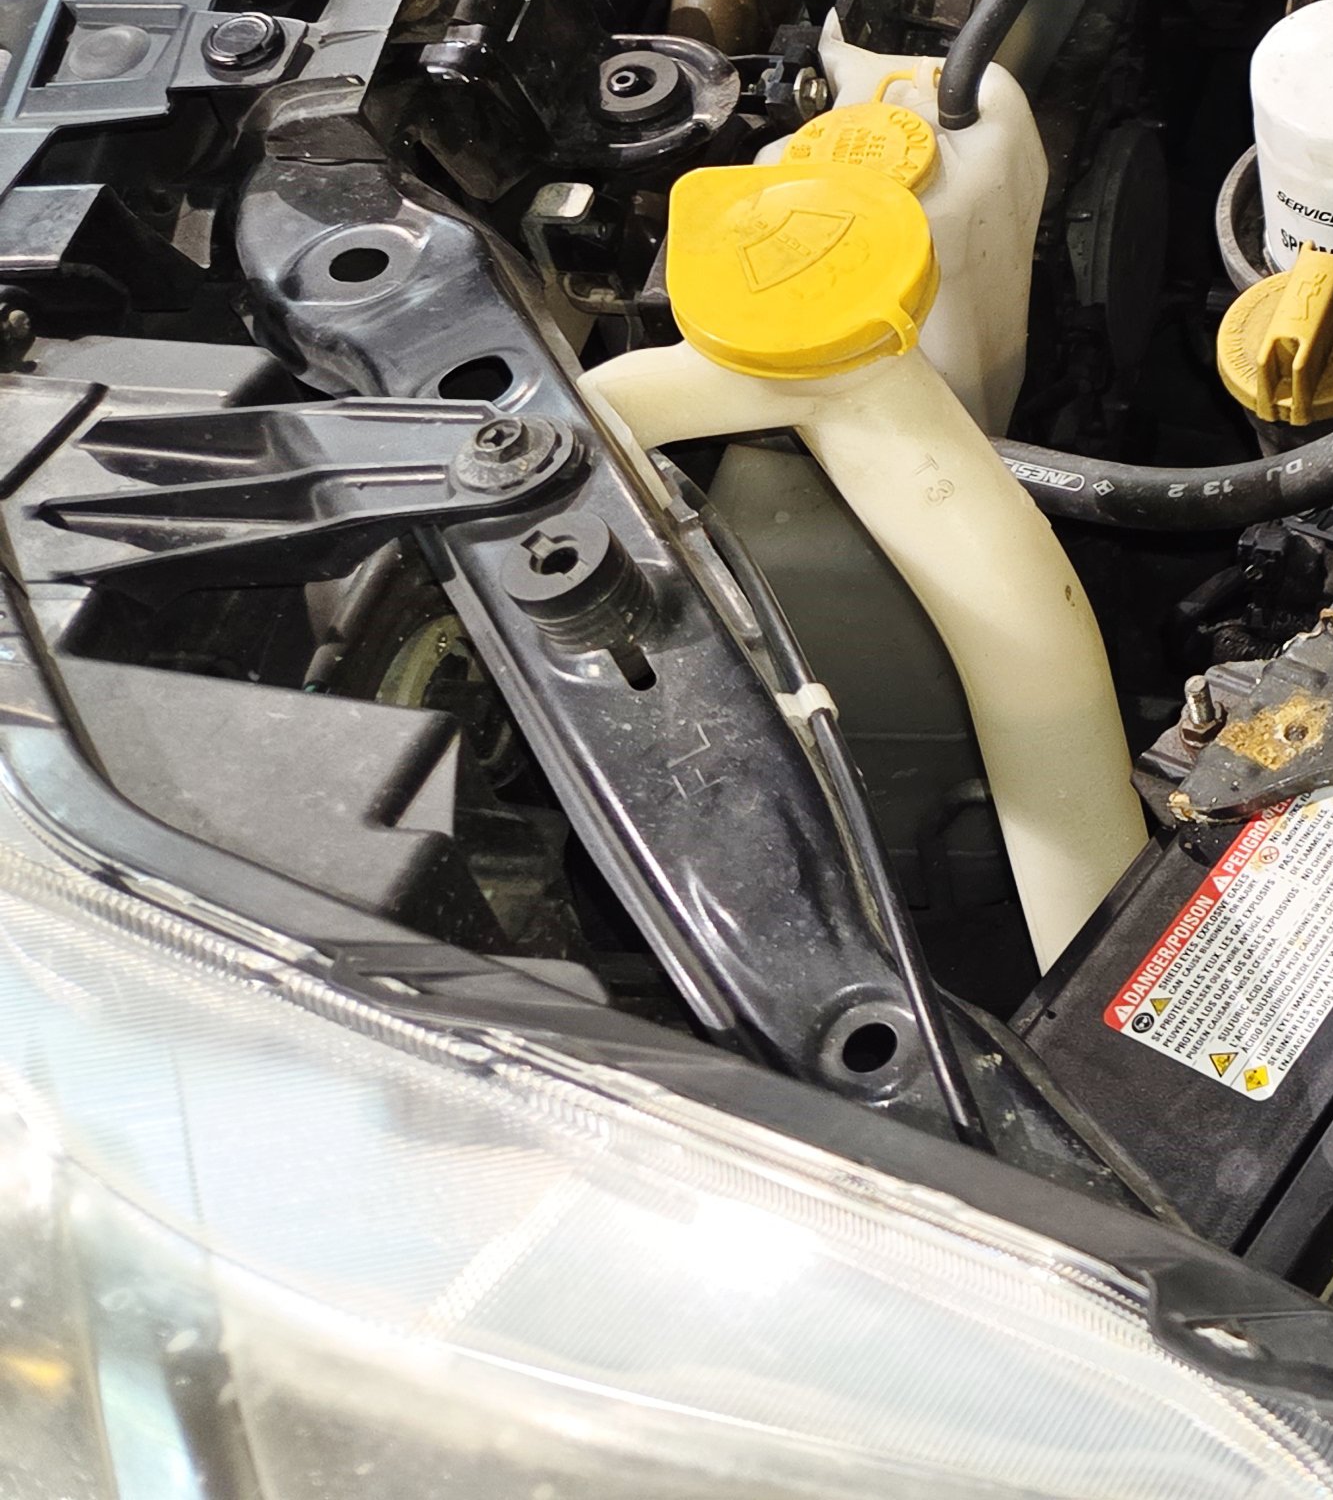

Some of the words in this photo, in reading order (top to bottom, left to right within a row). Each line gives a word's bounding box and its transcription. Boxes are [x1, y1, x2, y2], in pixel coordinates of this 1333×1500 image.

[888, 109, 929, 182] COOLAN
[1268, 828, 1283, 844] NO
[1277, 852, 1294, 871] PAS
[1280, 811, 1309, 847] SMOKING
[1288, 863, 1300, 876] DE
[1322, 818, 1333, 830] DE
[1300, 866, 1315, 882] NO
[1121, 890, 1216, 1007] DANGER/POISON
[1149, 1028, 1163, 1043] SE
[1189, 972, 1205, 990] LES
[1217, 933, 1234, 952] LES
[1229, 917, 1246, 936] GAZ
[1241, 877, 1276, 920] EXPLOSIFS
[1157, 959, 1184, 991] SHIELD
[1195, 897, 1231, 941] EXPLOSIVE
[1226, 871, 1250, 900] GASES
[1167, 977, 1184, 996] CAN
[1180, 952, 1202, 978] CAUSE
[1198, 913, 1231, 955] BLINDNESS
[1227, 902, 1240, 915] OR
[1173, 1015, 1206, 1055] PROTEJA
[1200, 997, 1218, 1018] LOS
[1230, 958, 1247, 977] LOS
[1242, 932, 1266, 961] GASES
[1261, 885, 1300, 935] EXPLOSIVOS
[1216, 1001, 1249, 1043] SULFURIC
[1244, 982, 1263, 1004] ACID
[1258, 966, 1275, 985] CAN
[1269, 944, 1290, 970] CAUSE
[1310, 900, 1323, 913] OR
[1250, 968, 1289, 1018] SULFURIQUE
[1284, 949, 1303, 970] PEUT
[1297, 922, 1321, 953] CAUSER
[1316, 913, 1328, 925] LA
[1288, 960, 1310, 986] PUEDE
[1305, 932, 1330, 963] CAUSAR
[1161, 1013, 1191, 1049] PEUVENT
[1186, 982, 1213, 1016] BLESSER
[1208, 971, 1222, 985] OU
[1217, 944, 1242, 974] RENDRE
[1184, 1028, 1211, 1061] PUEDEN
[1205, 998, 1233, 1031] CAUSAR
[1254, 1033, 1278, 1062] FLUSH
[1275, 1009, 1295, 1033] EYES
[1290, 957, 1332, 1012] IMMEDIATELY
[1265, 1052, 1279, 1067] SE
[1273, 1021, 1300, 1056] RINSER
[1295, 1006, 1311, 1025] LES
[1306, 985, 1326, 1009] YEUX
[1276, 1032, 1308, 1073] ENJUAGE
[1303, 1014, 1320, 1034] LOS
